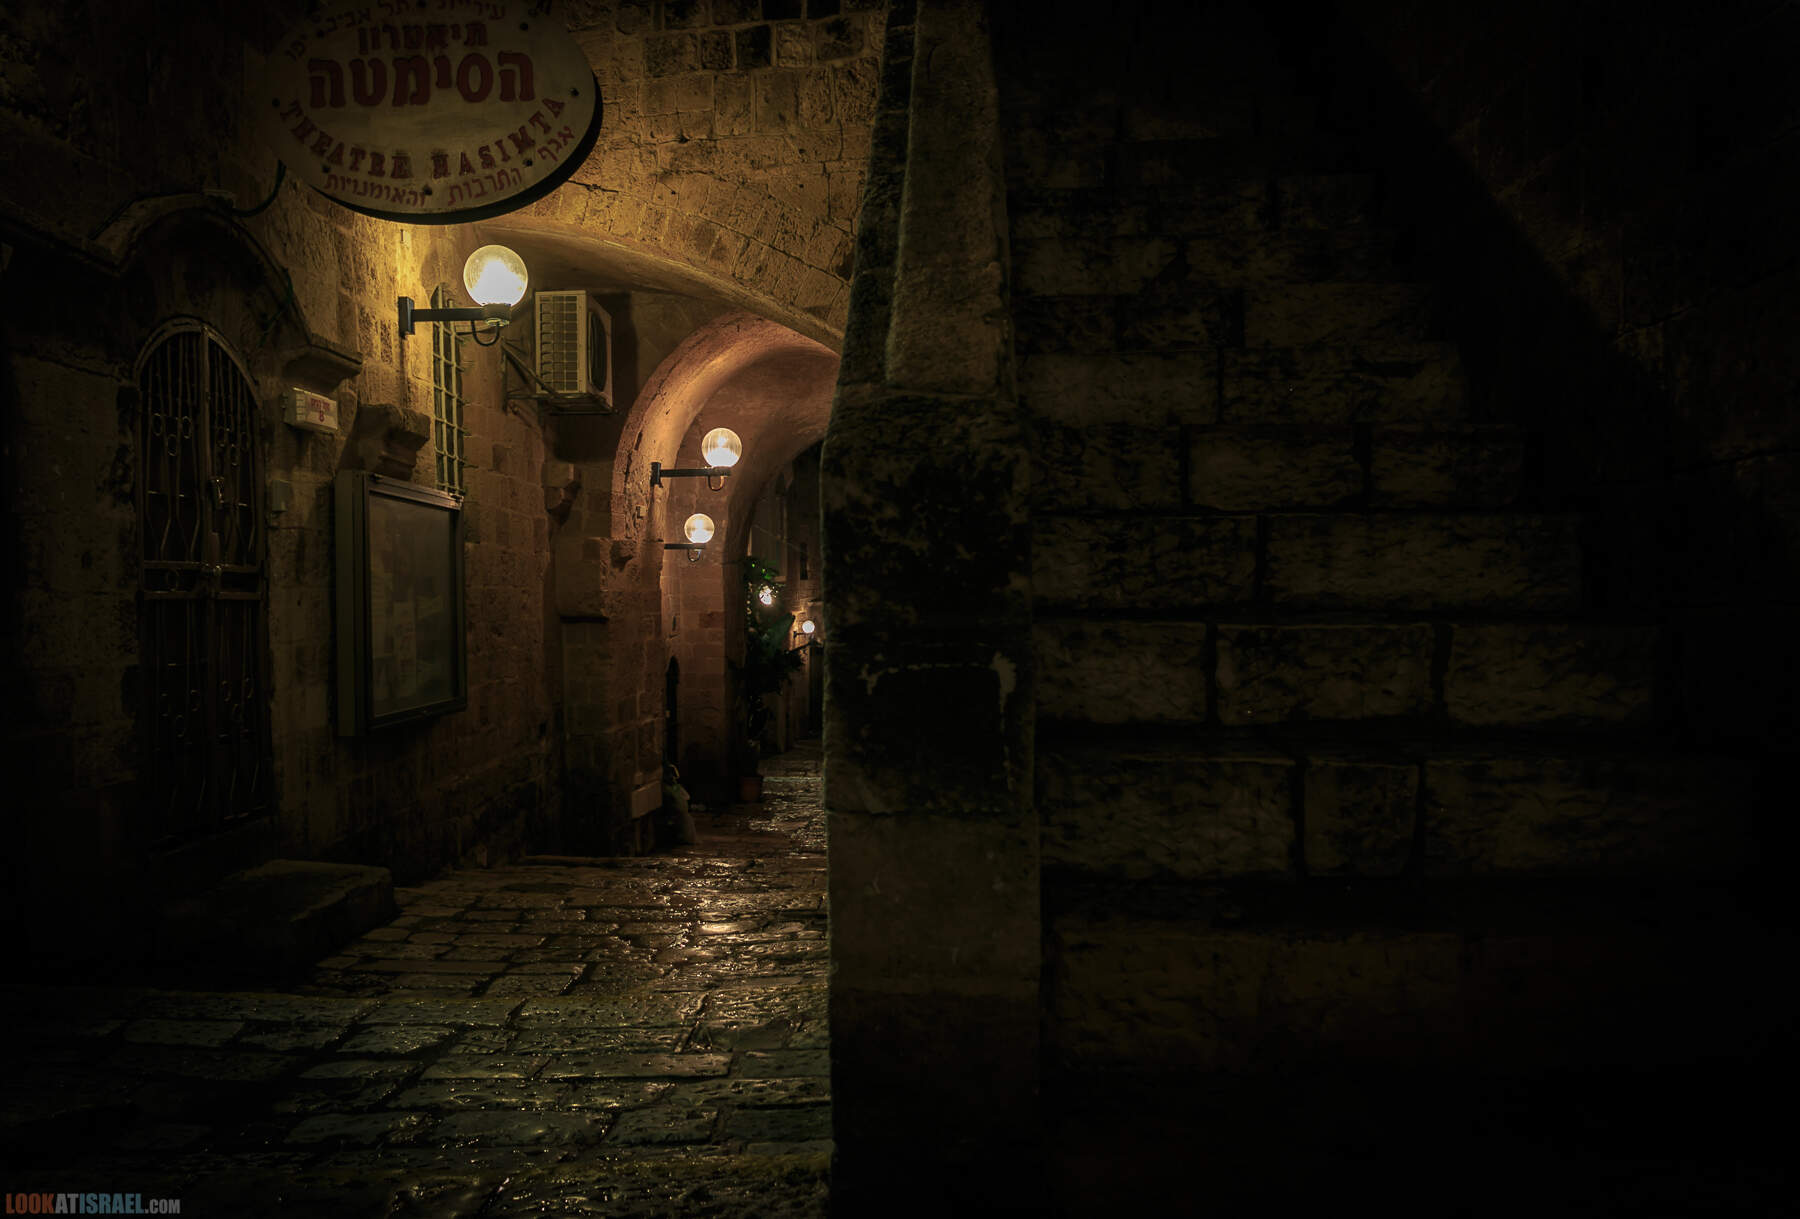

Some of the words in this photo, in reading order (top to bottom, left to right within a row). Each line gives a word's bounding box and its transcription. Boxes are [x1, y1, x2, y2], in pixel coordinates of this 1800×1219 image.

[358, 22, 488, 54] תיאטרון
[307, 51, 535, 108] הסימטה
[280, 99, 413, 179] THEATRE
[431, 98, 565, 179] HASIMTA
[537, 126, 574, 161] אגף
[448, 168, 522, 206] התרבות
